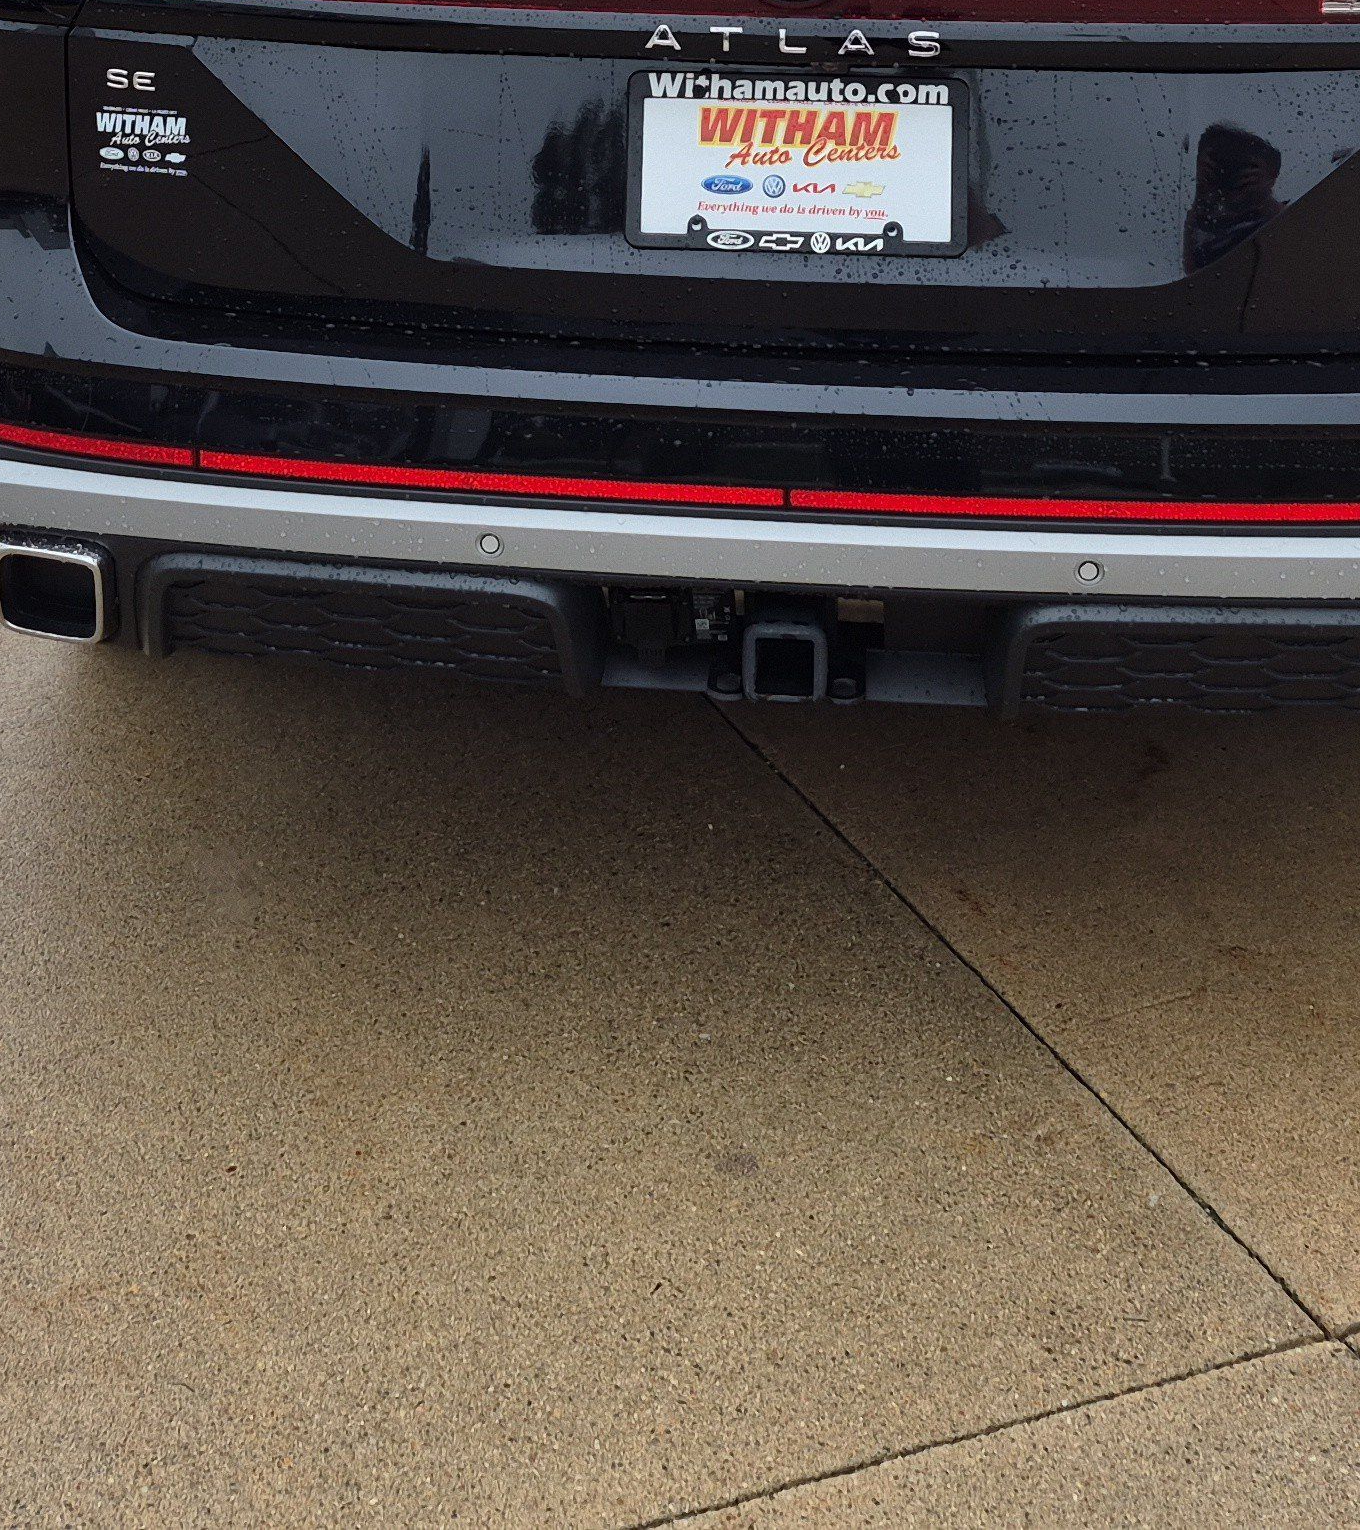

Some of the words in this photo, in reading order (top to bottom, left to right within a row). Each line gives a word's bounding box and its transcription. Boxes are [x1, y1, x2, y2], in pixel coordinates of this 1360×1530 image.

[645, 24, 941, 57] ATLAS
[106, 68, 156, 92] SE
[648, 72, 949, 105] Withamauto.com
[96, 112, 187, 136] WITHAM
[700, 107, 896, 147] WITHAM
[110, 131, 141, 145] Auto
[144, 130, 191, 147] Centers
[724, 141, 791, 169] Auto
[802, 137, 902, 168] Centers
[711, 177, 744, 191] Ford
[697, 201, 759, 215] Everything
[761, 205, 778, 213] we
[779, 204, 794, 214] do
[796, 205, 807, 214] is
[808, 205, 846, 215] driven
[848, 206, 862, 219] by
